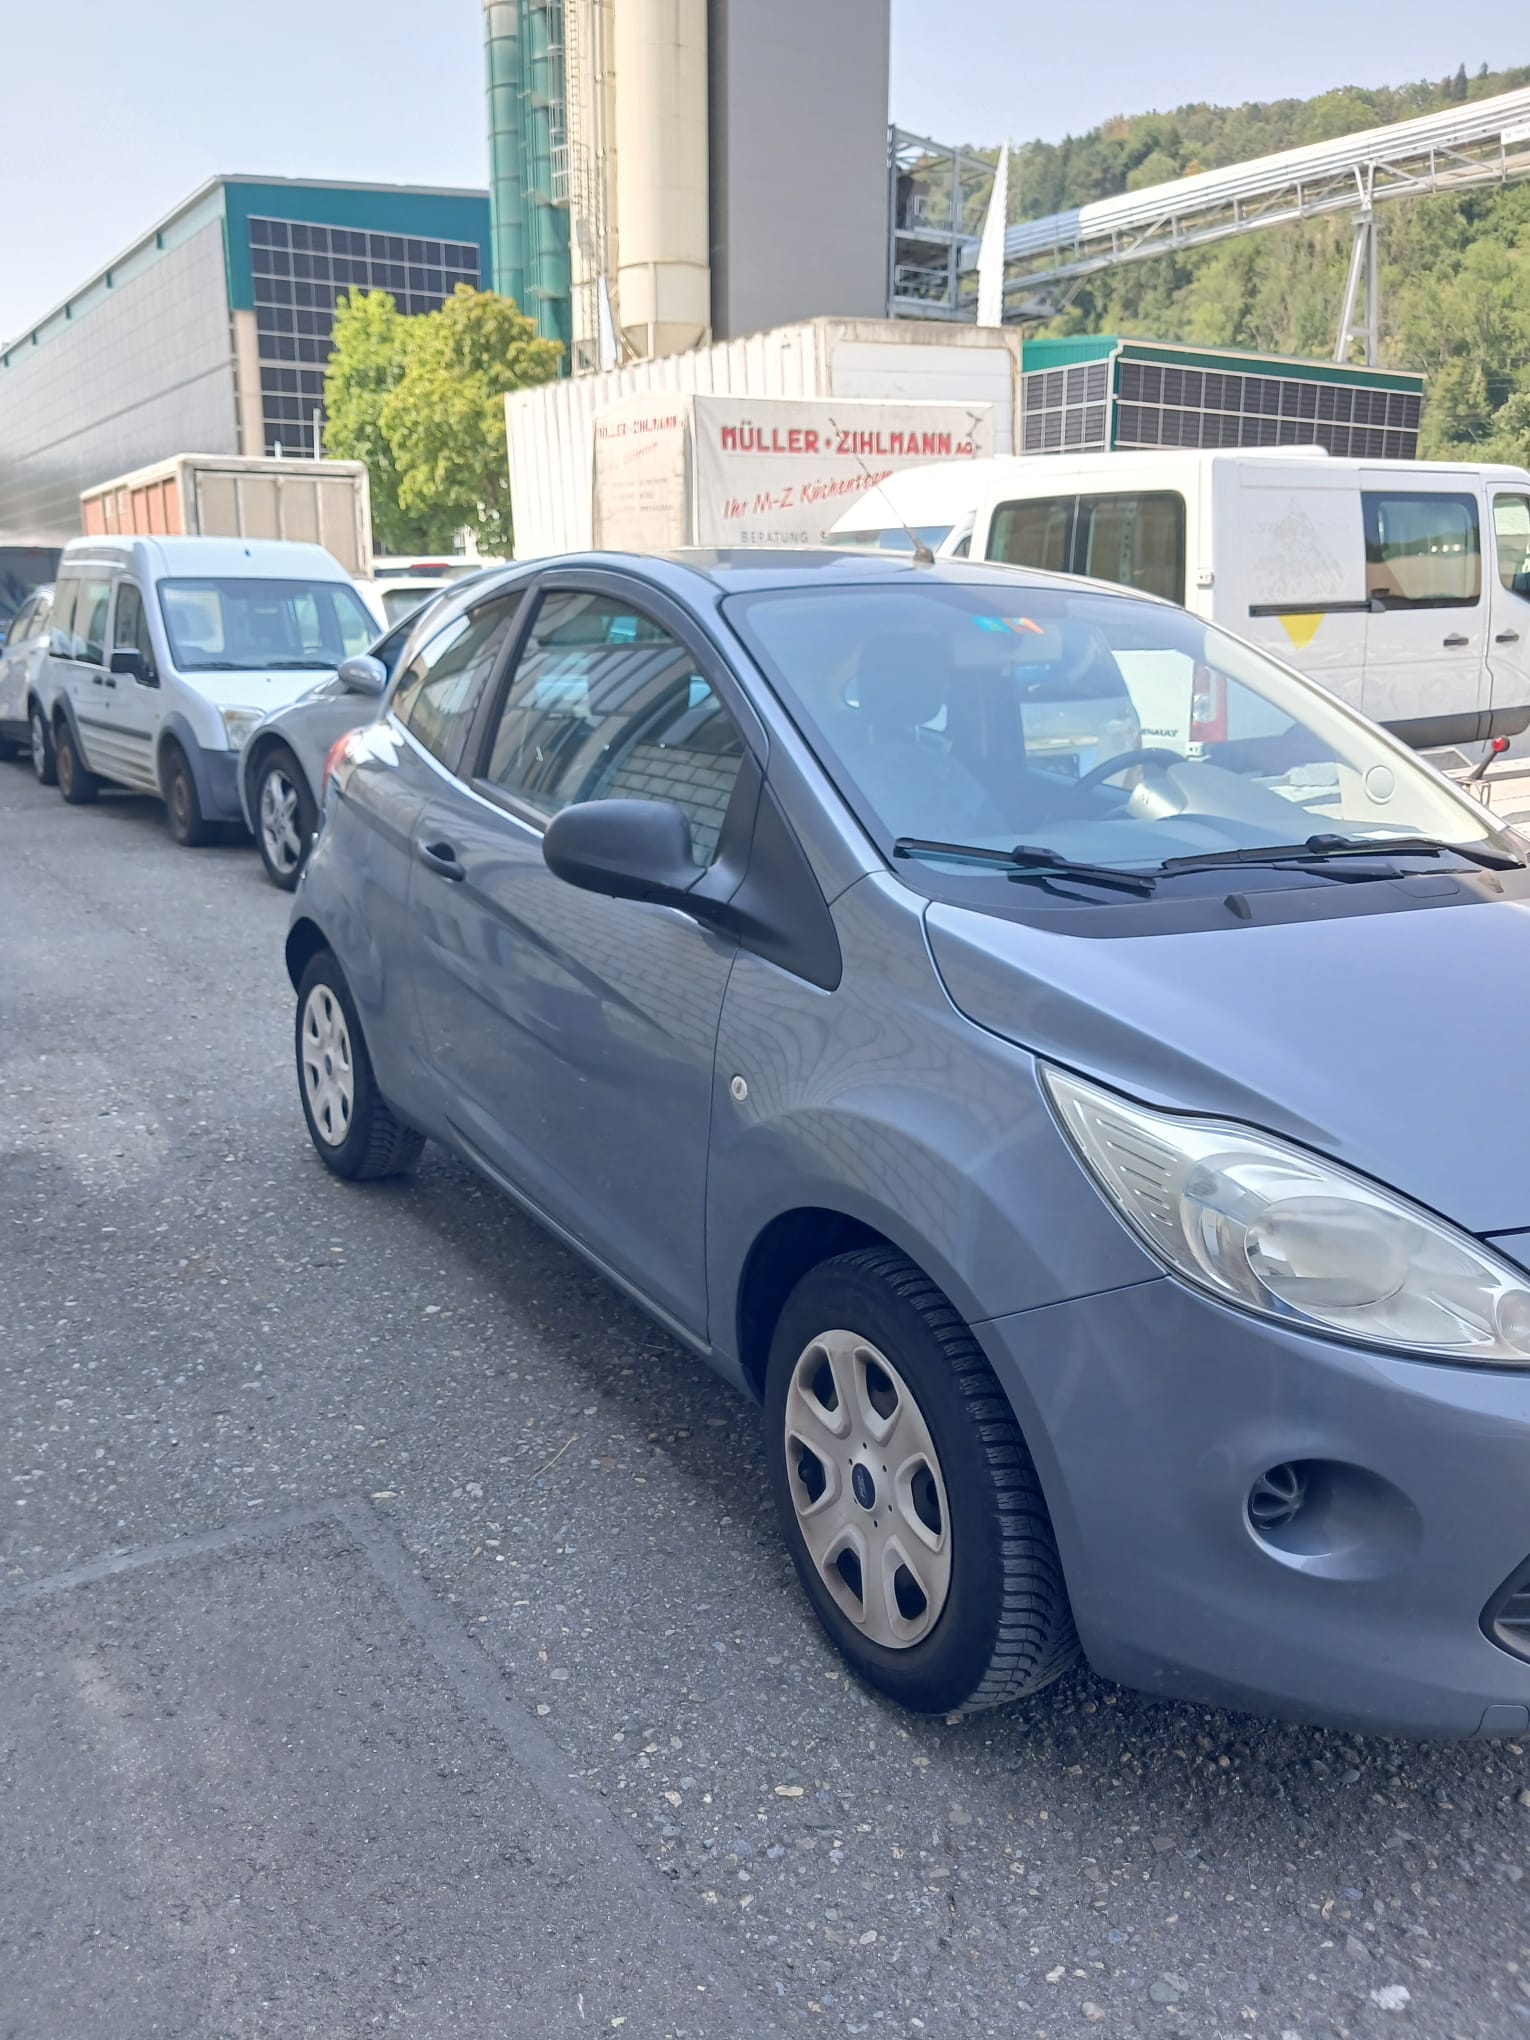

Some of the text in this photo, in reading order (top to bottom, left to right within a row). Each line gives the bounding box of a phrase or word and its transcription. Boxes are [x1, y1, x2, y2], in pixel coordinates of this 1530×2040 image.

[721, 420, 974, 456] MÜLLER ZIHLMANN AG
[723, 497, 749, 520] Ihr
[753, 486, 793, 515] M-Z
[740, 530, 809, 544] BERATUNG
[1141, 727, 1178, 738] ENAULT
